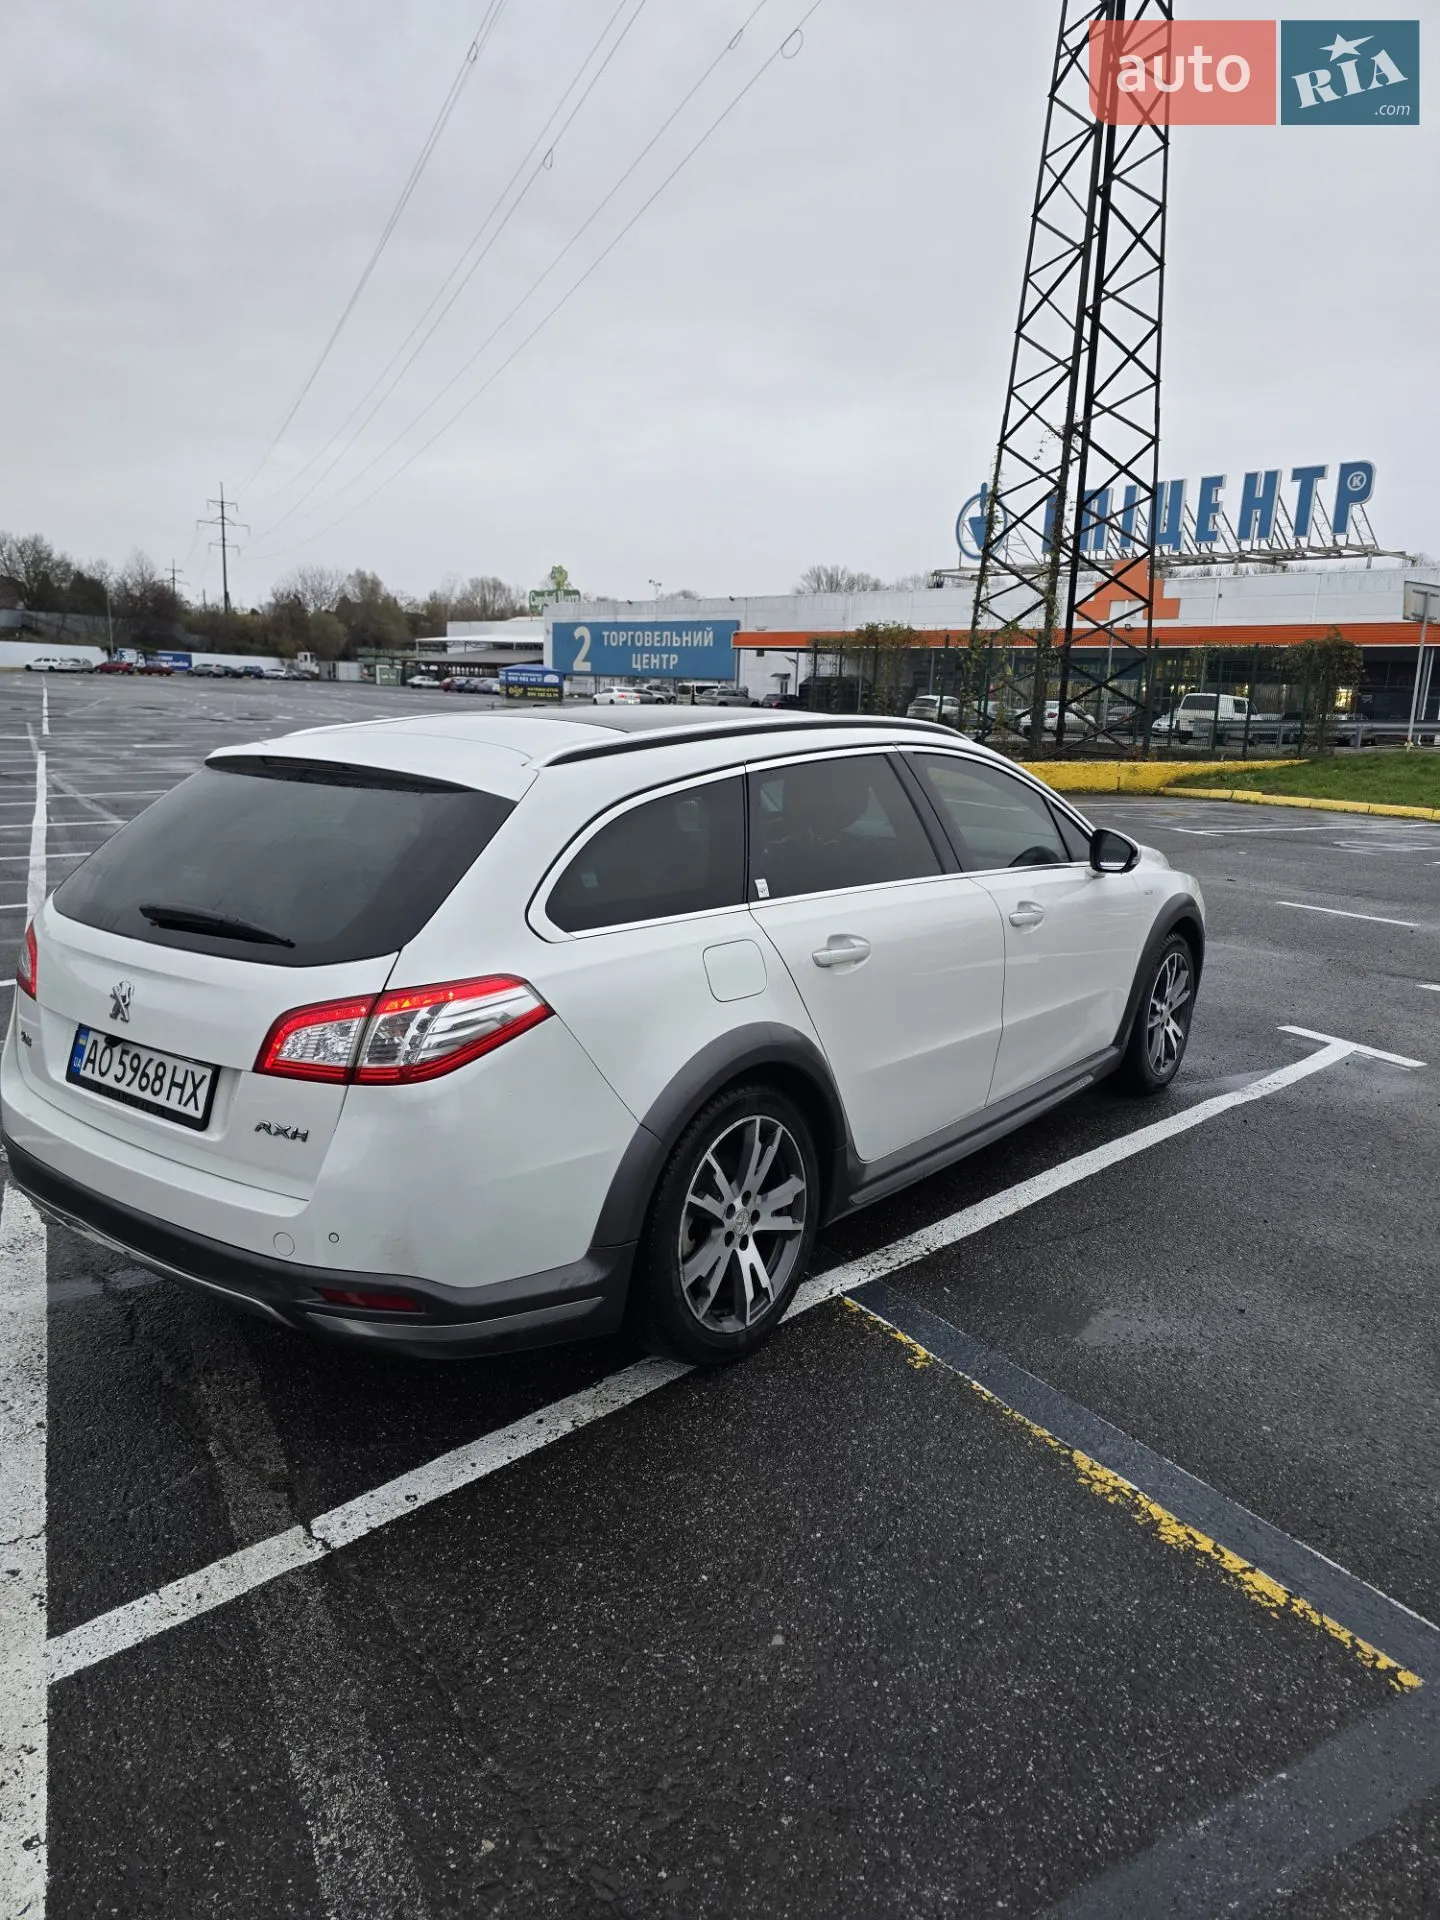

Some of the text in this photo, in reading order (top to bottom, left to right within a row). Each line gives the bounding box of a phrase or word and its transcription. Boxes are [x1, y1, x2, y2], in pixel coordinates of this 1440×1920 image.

[602, 627, 714, 647] ТОРГОВЕЛЬНИЙ
[572, 626, 592, 672] 2
[632, 653, 679, 671] ЦЕНТР
[73, 1057, 82, 1069] UA
[254, 1119, 310, 1143] RXH
